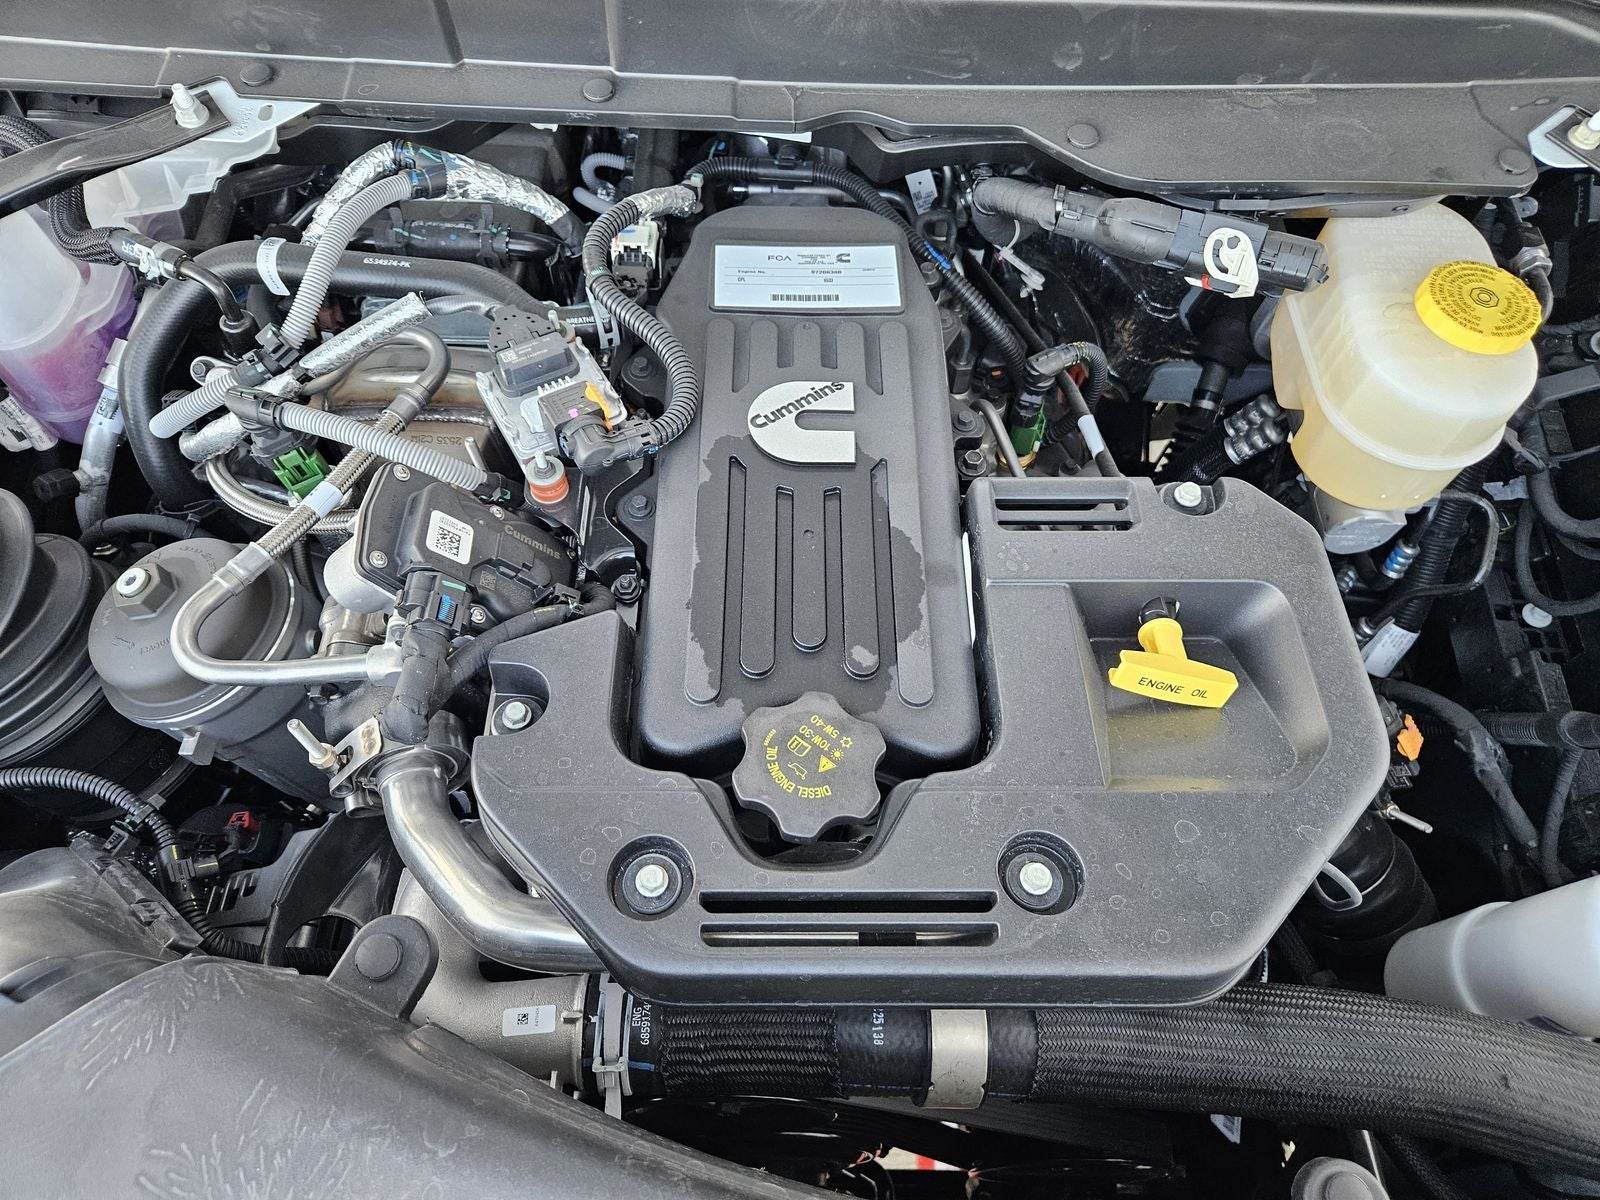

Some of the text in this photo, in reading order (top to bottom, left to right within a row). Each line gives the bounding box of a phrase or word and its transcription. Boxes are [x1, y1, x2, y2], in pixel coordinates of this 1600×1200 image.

[767, 254, 792, 262] FCA
[750, 381, 845, 428] Cummins
[504, 524, 561, 560] Cummins
[1138, 676, 1208, 699] ENGINE OIL
[799, 724, 831, 751] 10W-30
[810, 714, 840, 739] 5W-40
[766, 745, 832, 799] DIESEL ENGINE OIL
[631, 1006, 642, 1027] ENG
